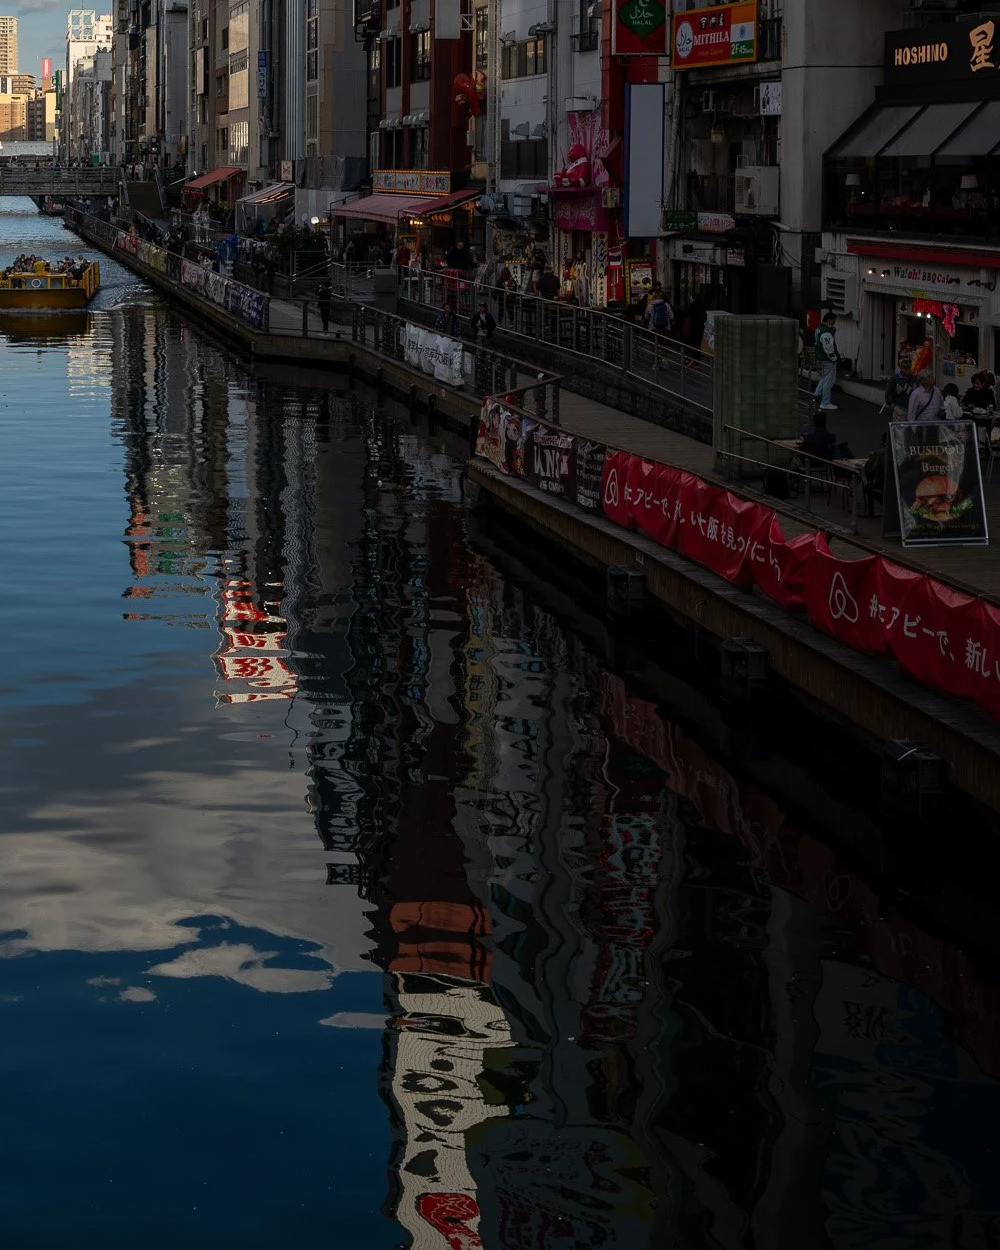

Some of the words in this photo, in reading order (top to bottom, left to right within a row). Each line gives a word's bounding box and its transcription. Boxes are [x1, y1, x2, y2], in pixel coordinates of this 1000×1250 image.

[693, 30, 731, 46] MITHILA
[894, 42, 949, 67] HOSHINO
[921, 271, 937, 284] BBQ
[909, 444, 965, 457] BUSIDOU
